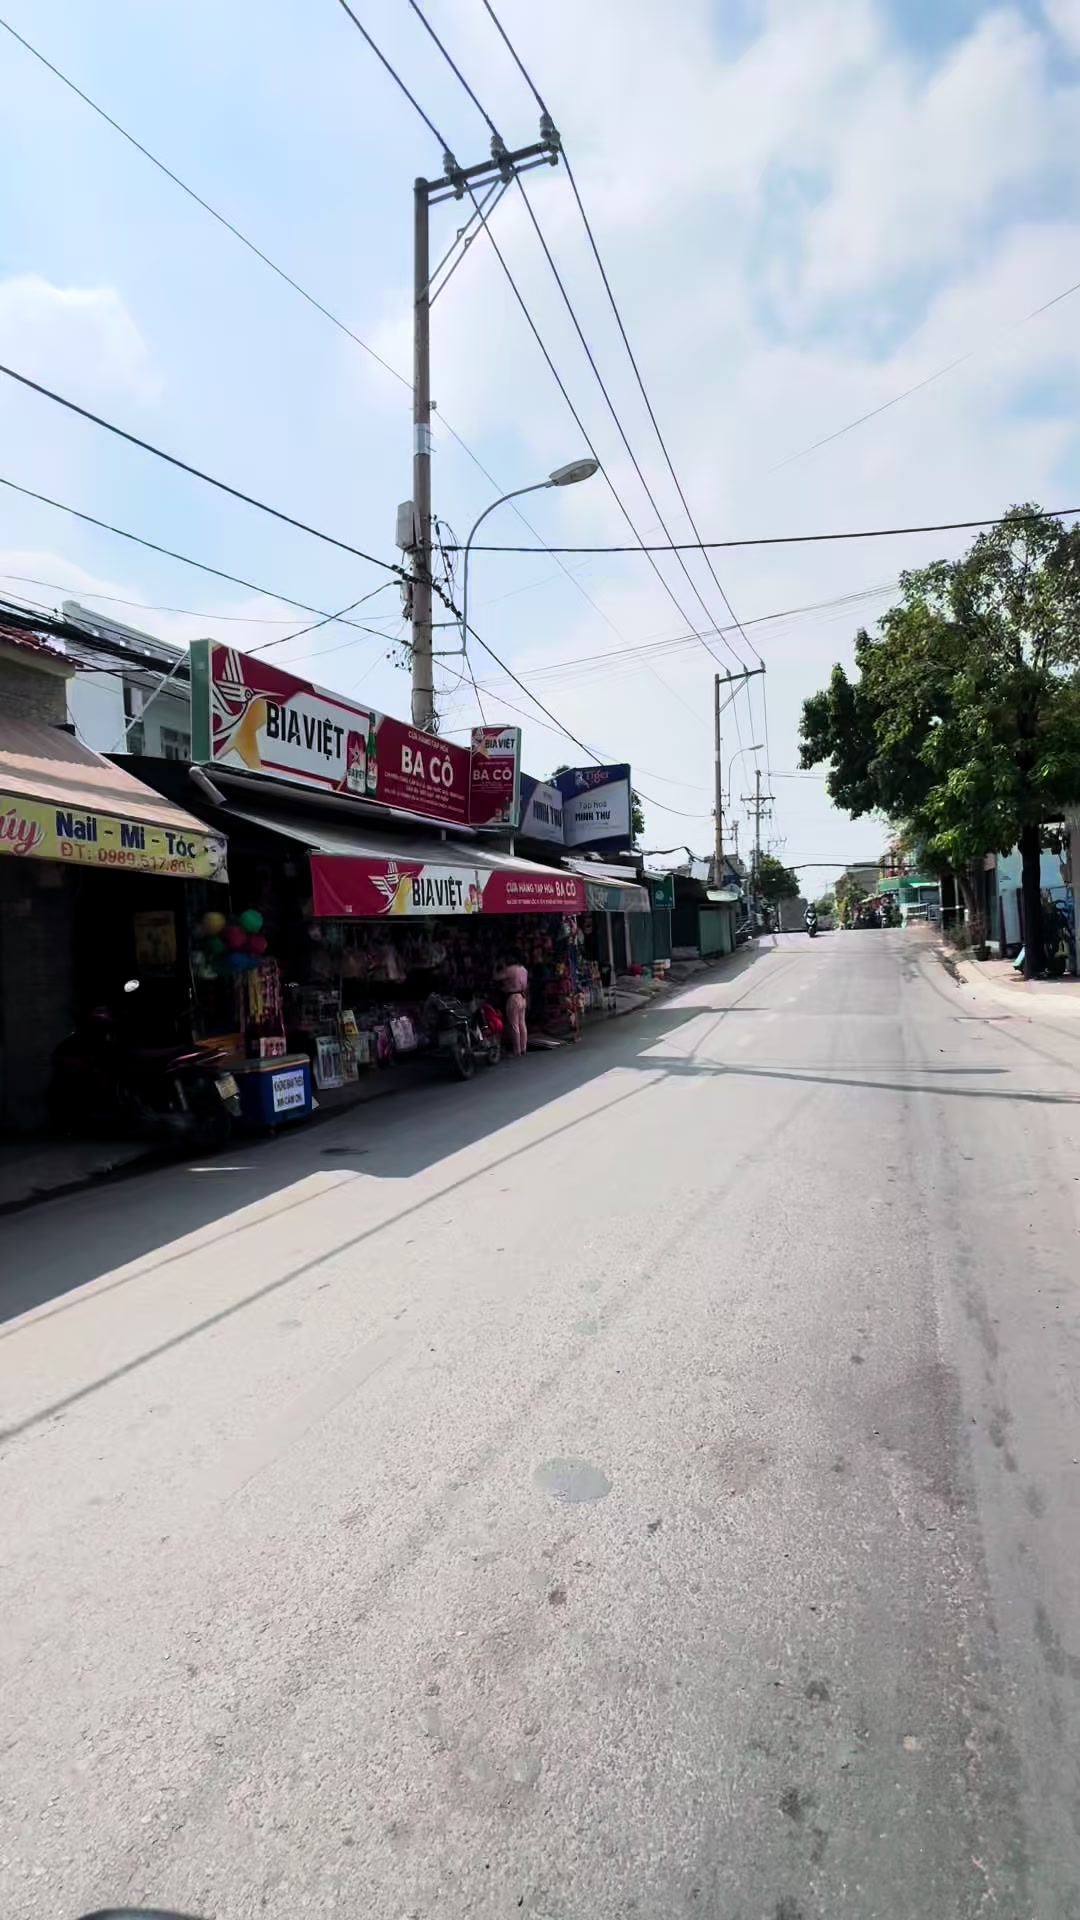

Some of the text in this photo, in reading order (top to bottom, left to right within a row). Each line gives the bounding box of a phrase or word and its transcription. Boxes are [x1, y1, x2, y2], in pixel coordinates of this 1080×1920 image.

[401, 744, 425, 779] BA
[429, 754, 454, 787] CÔ
[473, 766, 512, 781] BA CÔ
[584, 769, 609, 784] Tiger
[575, 810, 611, 823] MINH THƯ
[55, 810, 97, 842] Nail
[120, 823, 145, 850] Mi
[165, 831, 197, 859] Tóc
[555, 880, 565, 897] BA
[566, 879, 576, 897] CÔ
